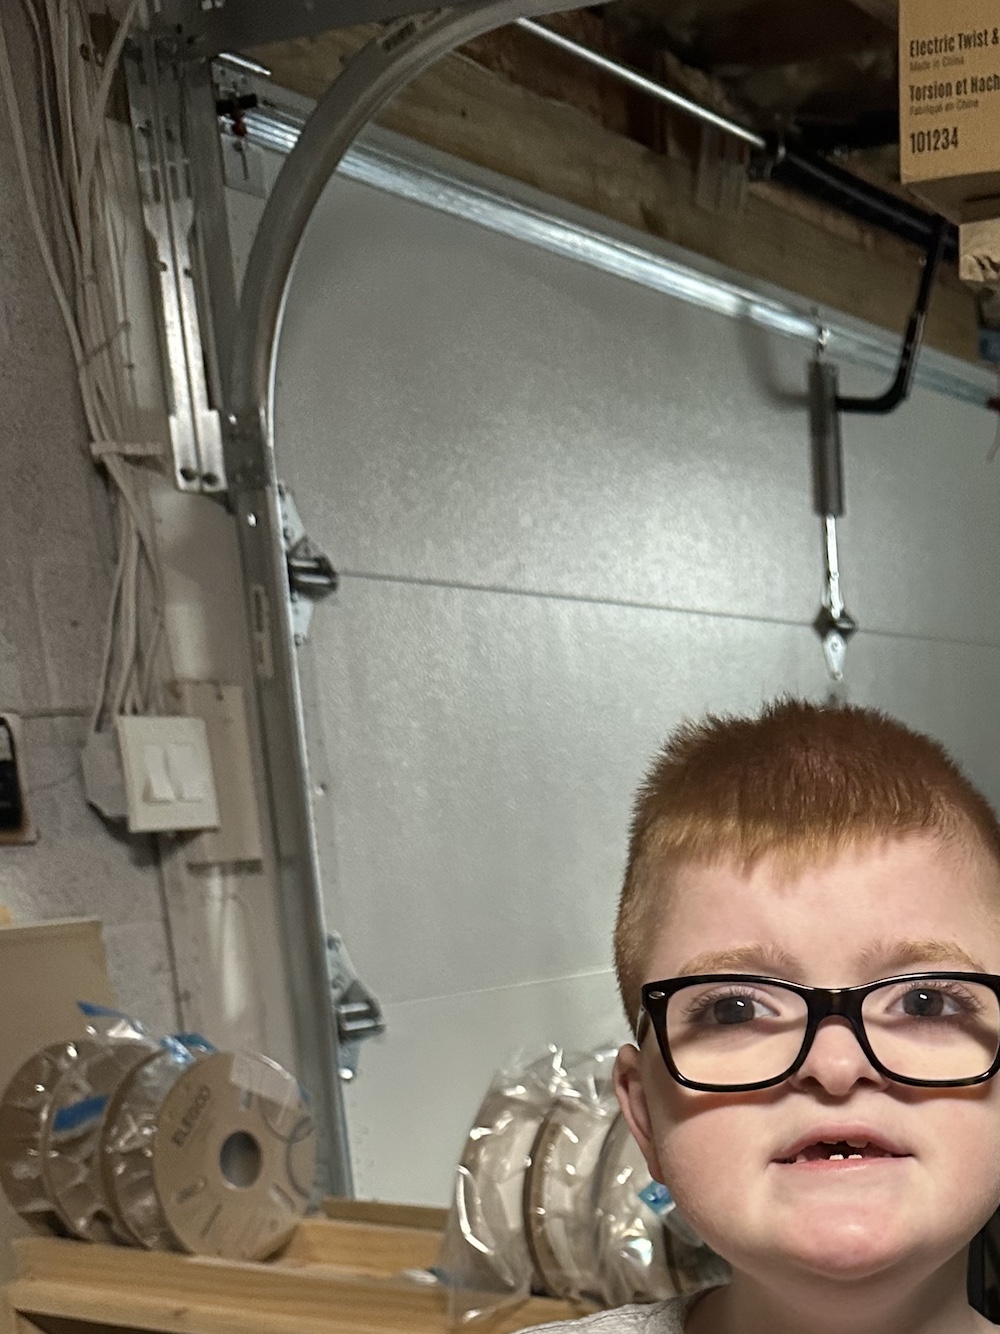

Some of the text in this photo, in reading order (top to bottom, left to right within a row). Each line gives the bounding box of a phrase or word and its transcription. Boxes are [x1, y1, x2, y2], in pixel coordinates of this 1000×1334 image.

[909, 34, 955, 58] Electric
[957, 28, 989, 51] Twist
[991, 27, 1000, 45] &
[909, 81, 953, 102] Torsion
[955, 78, 967, 96] et
[910, 126, 959, 154] 101234
